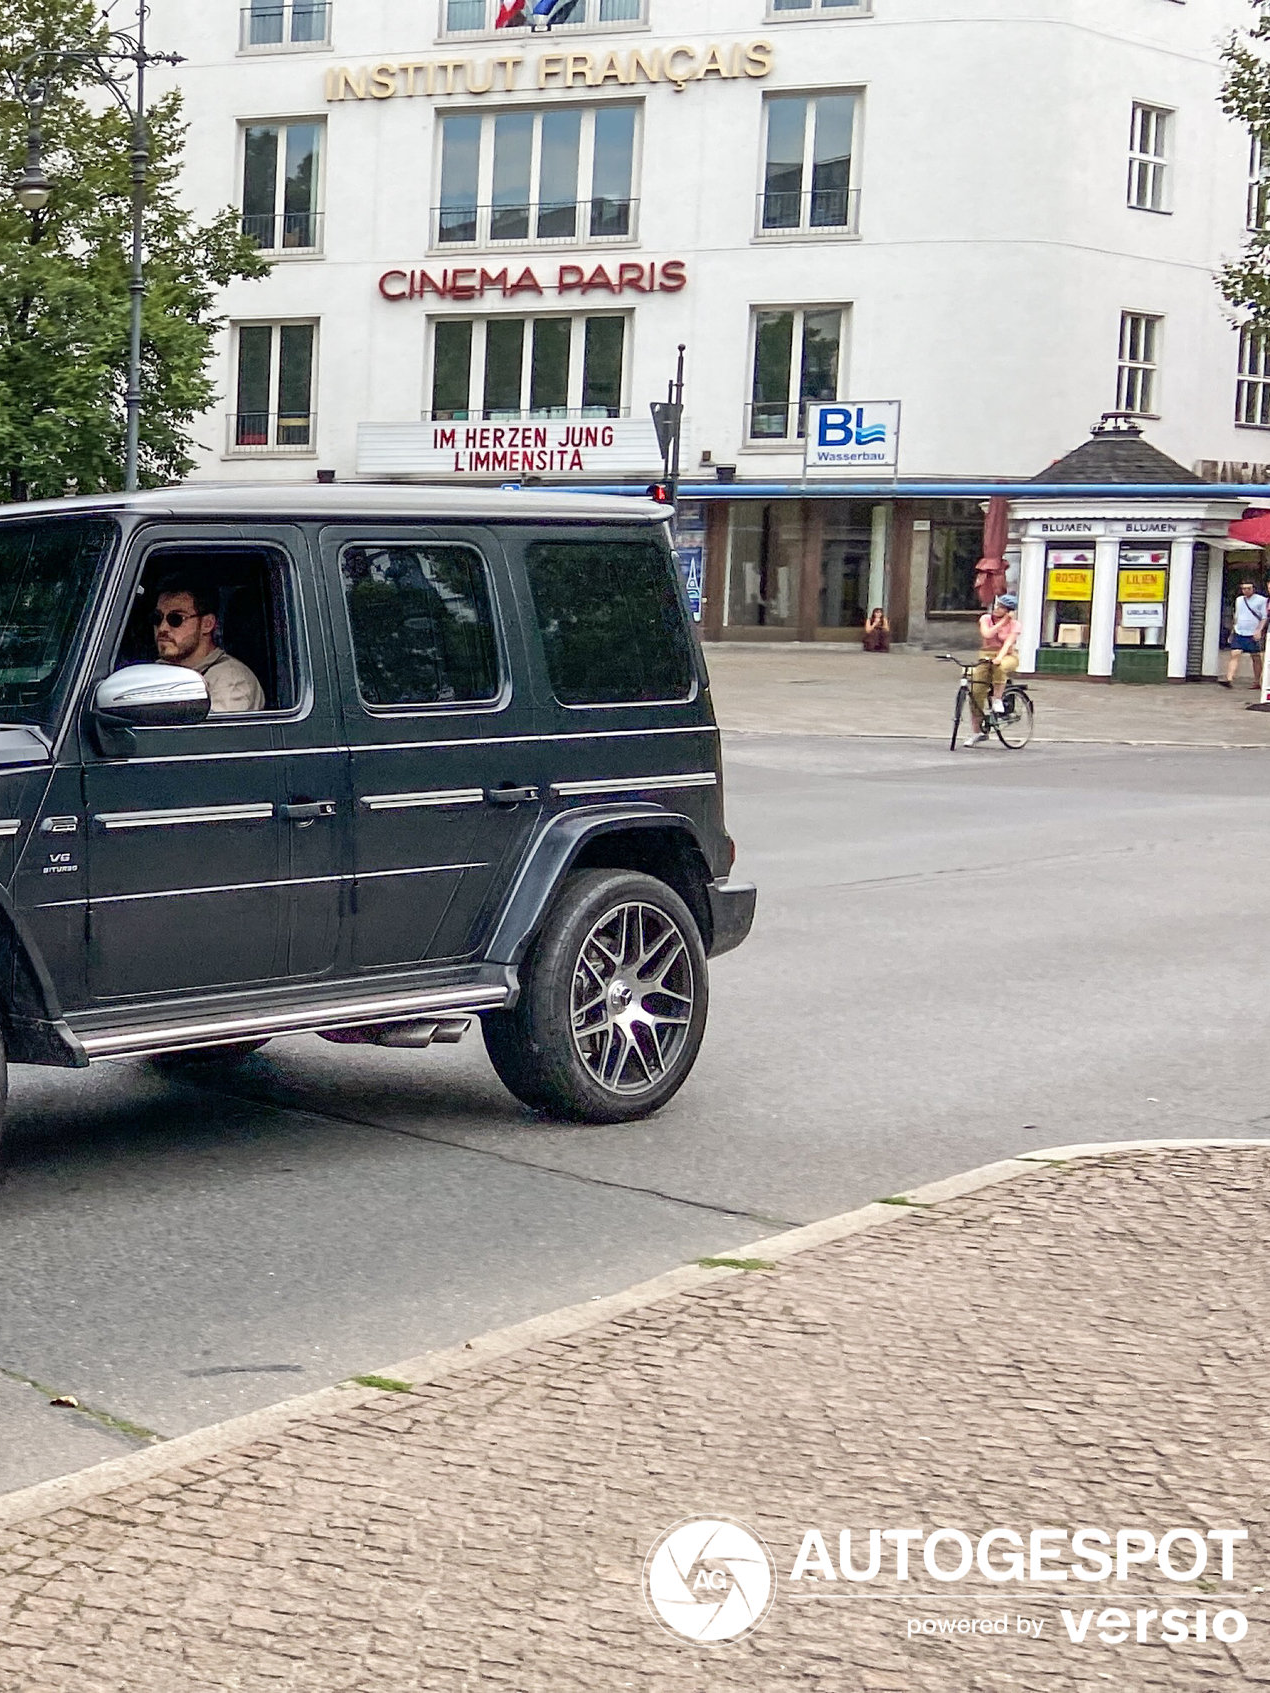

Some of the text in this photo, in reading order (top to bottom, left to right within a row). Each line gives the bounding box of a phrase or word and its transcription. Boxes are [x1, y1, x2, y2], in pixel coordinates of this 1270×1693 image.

[325, 39, 774, 101] INSTITUT FRANÇAIS
[379, 260, 687, 301] CINEMA PARIS
[433, 426, 614, 449] IM HERZEN JUNG
[817, 452, 885, 461] Wasserbau
[1042, 523, 1092, 532] BLUMEN
[1126, 523, 1177, 532] BLUMEN
[1055, 573, 1088, 583] ROSEN
